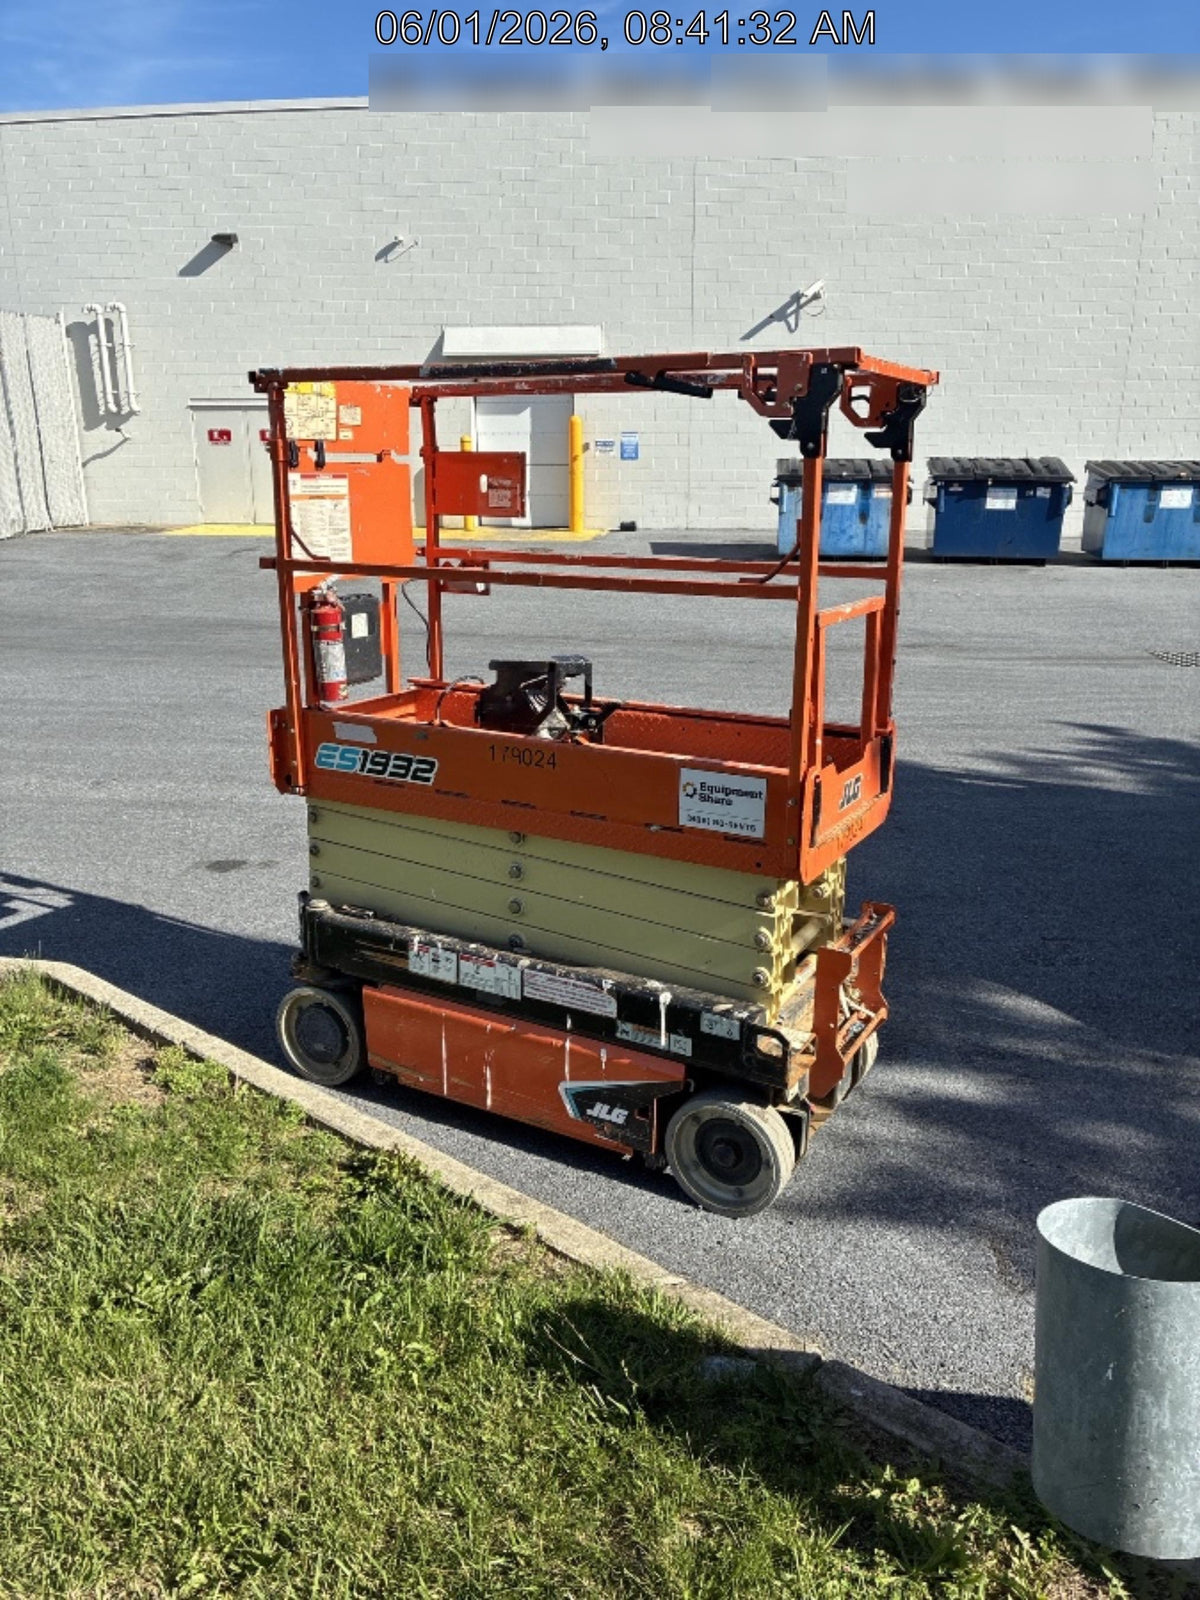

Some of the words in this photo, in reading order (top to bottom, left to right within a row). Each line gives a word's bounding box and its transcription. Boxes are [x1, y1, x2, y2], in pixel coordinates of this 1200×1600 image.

[315, 743, 438, 786] ES1932
[489, 744, 556, 770] 179024
[698, 793, 733, 806] Share
[699, 782, 763, 800] Equipment
[586, 1102, 629, 1125] JLG
